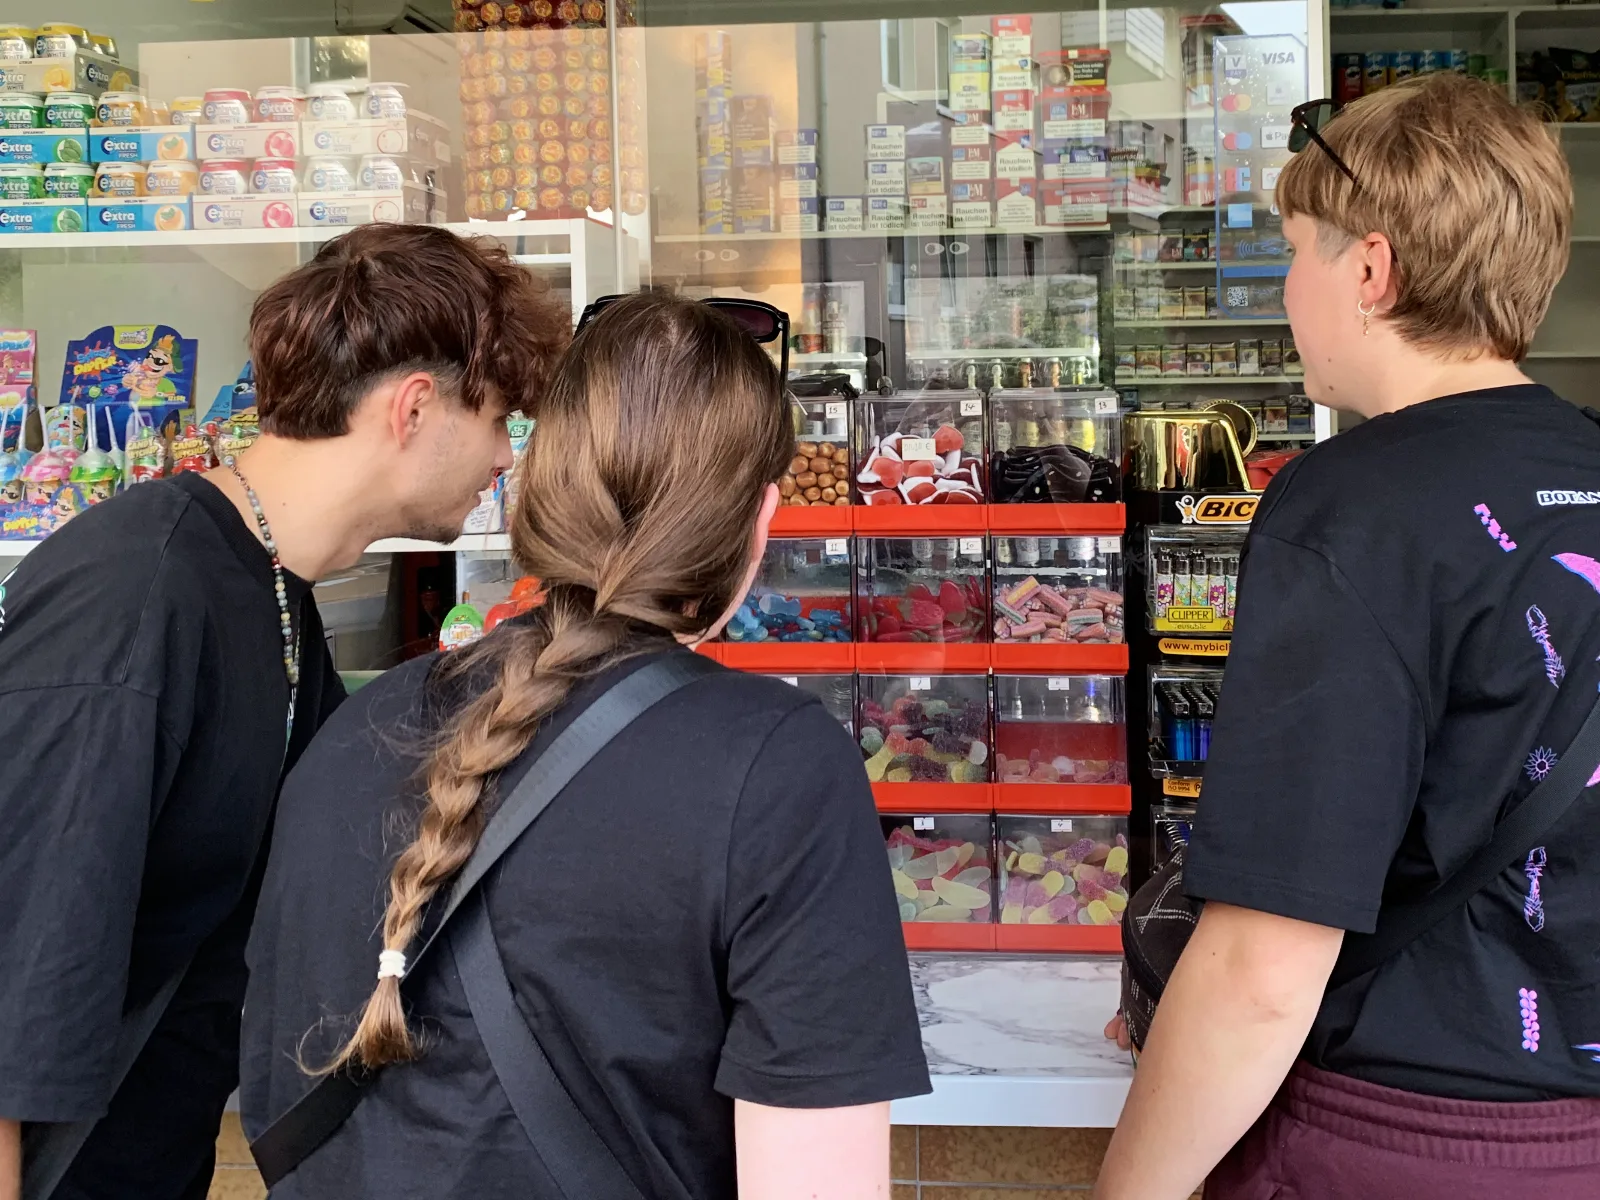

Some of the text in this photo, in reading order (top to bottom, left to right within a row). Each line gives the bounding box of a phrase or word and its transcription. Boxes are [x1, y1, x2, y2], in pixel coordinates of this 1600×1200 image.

[1232, 56, 1241, 68] V
[1262, 52, 1295, 65] VISA
[99, 106, 132, 118] extra
[259, 102, 294, 115] extra
[47, 109, 83, 121] extra
[0, 141, 33, 152] extra
[104, 140, 137, 151] extra
[210, 137, 245, 148] extra
[0, 181, 30, 191] xtra
[45, 180, 79, 191] extra
[100, 177, 135, 188] extra
[147, 176, 179, 187] extra
[102, 211, 135, 222] extra
[207, 208, 243, 219] extra
[313, 206, 348, 216] extra
[0, 212, 33, 223] extra
[73, 355, 117, 376] DIPPER
[964, 402, 976, 412] 14
[1098, 401, 1108, 410] 13
[128, 436, 155, 451] CANDY
[172, 437, 206, 451] CANDY
[1171, 609, 1209, 620] CLIPPER
